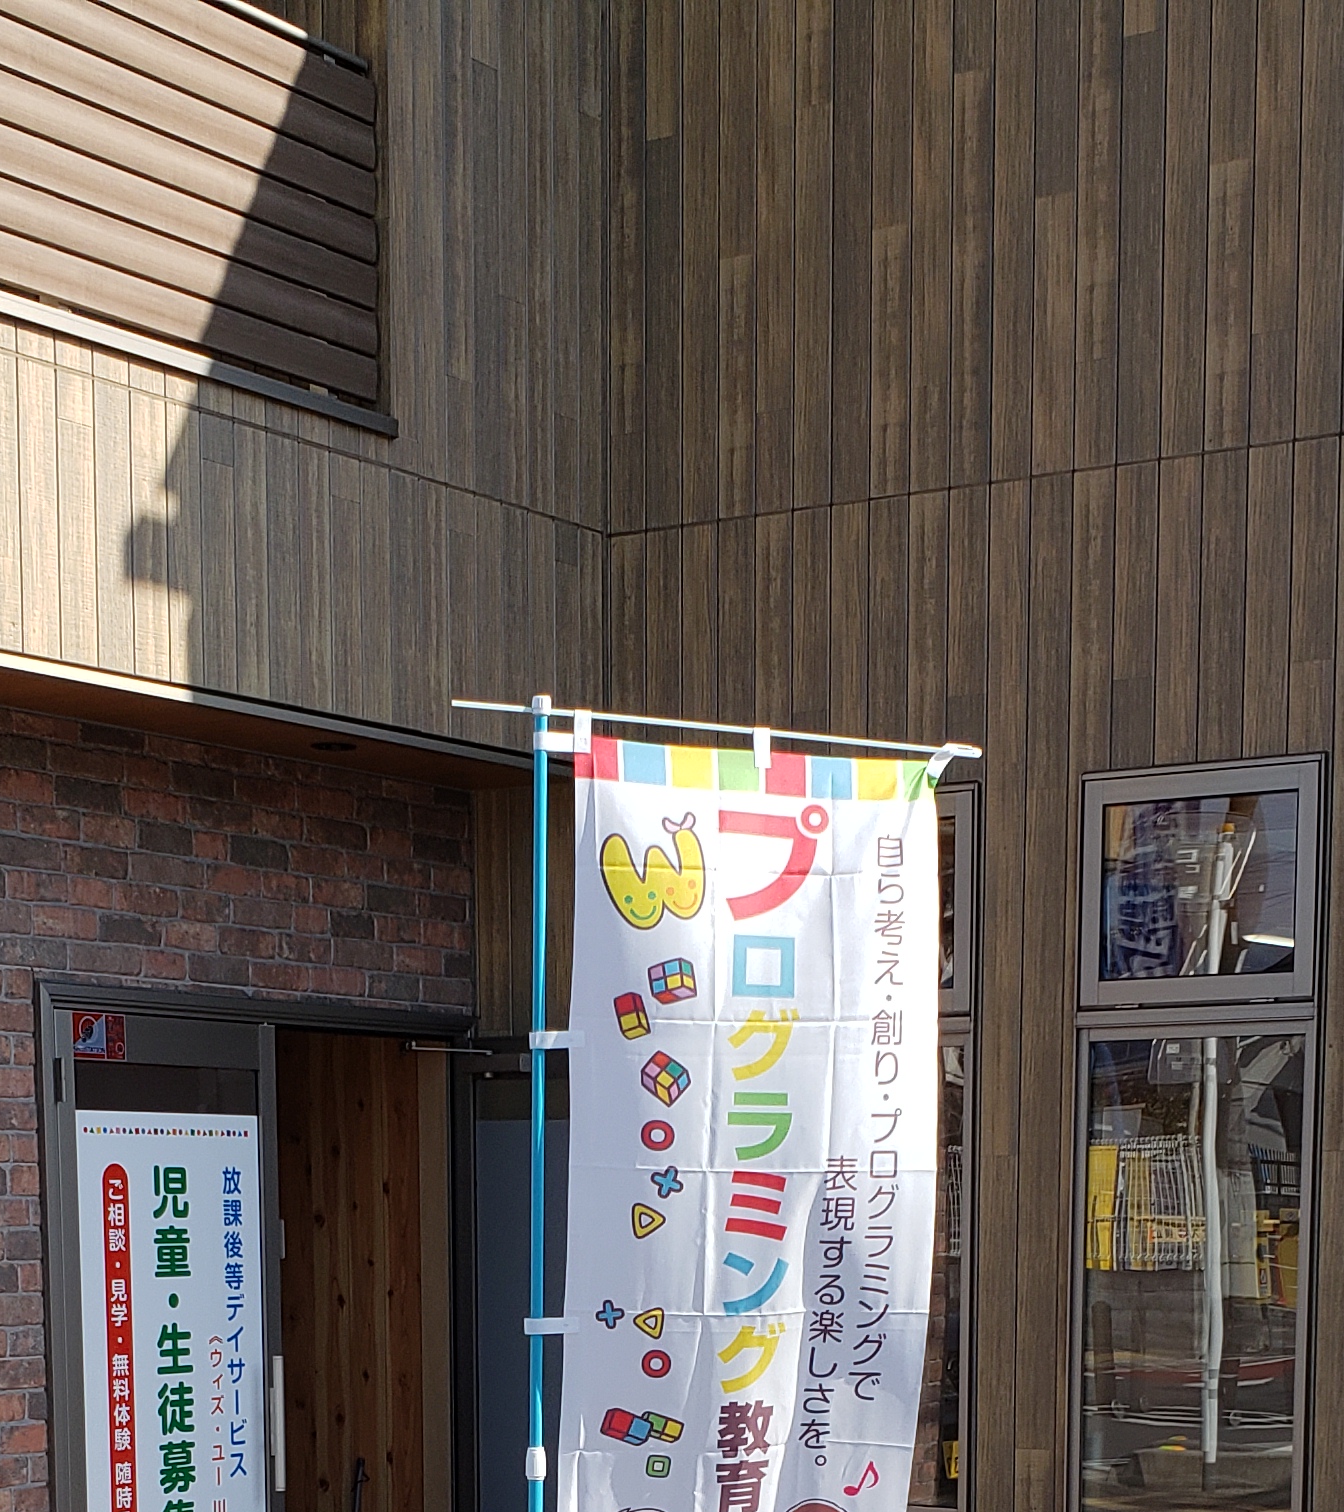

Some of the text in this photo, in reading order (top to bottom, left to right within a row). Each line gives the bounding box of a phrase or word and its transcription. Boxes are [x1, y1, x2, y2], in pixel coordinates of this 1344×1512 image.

[848, 834, 906, 1401] 自ら考え・創り・プログラミングで
[107, 1178, 133, 1452] ご相談・見学・無料体験
[221, 1166, 249, 1478] 放課後等デイサービス
[798, 1155, 858, 1468] 表現する楽しさを。
